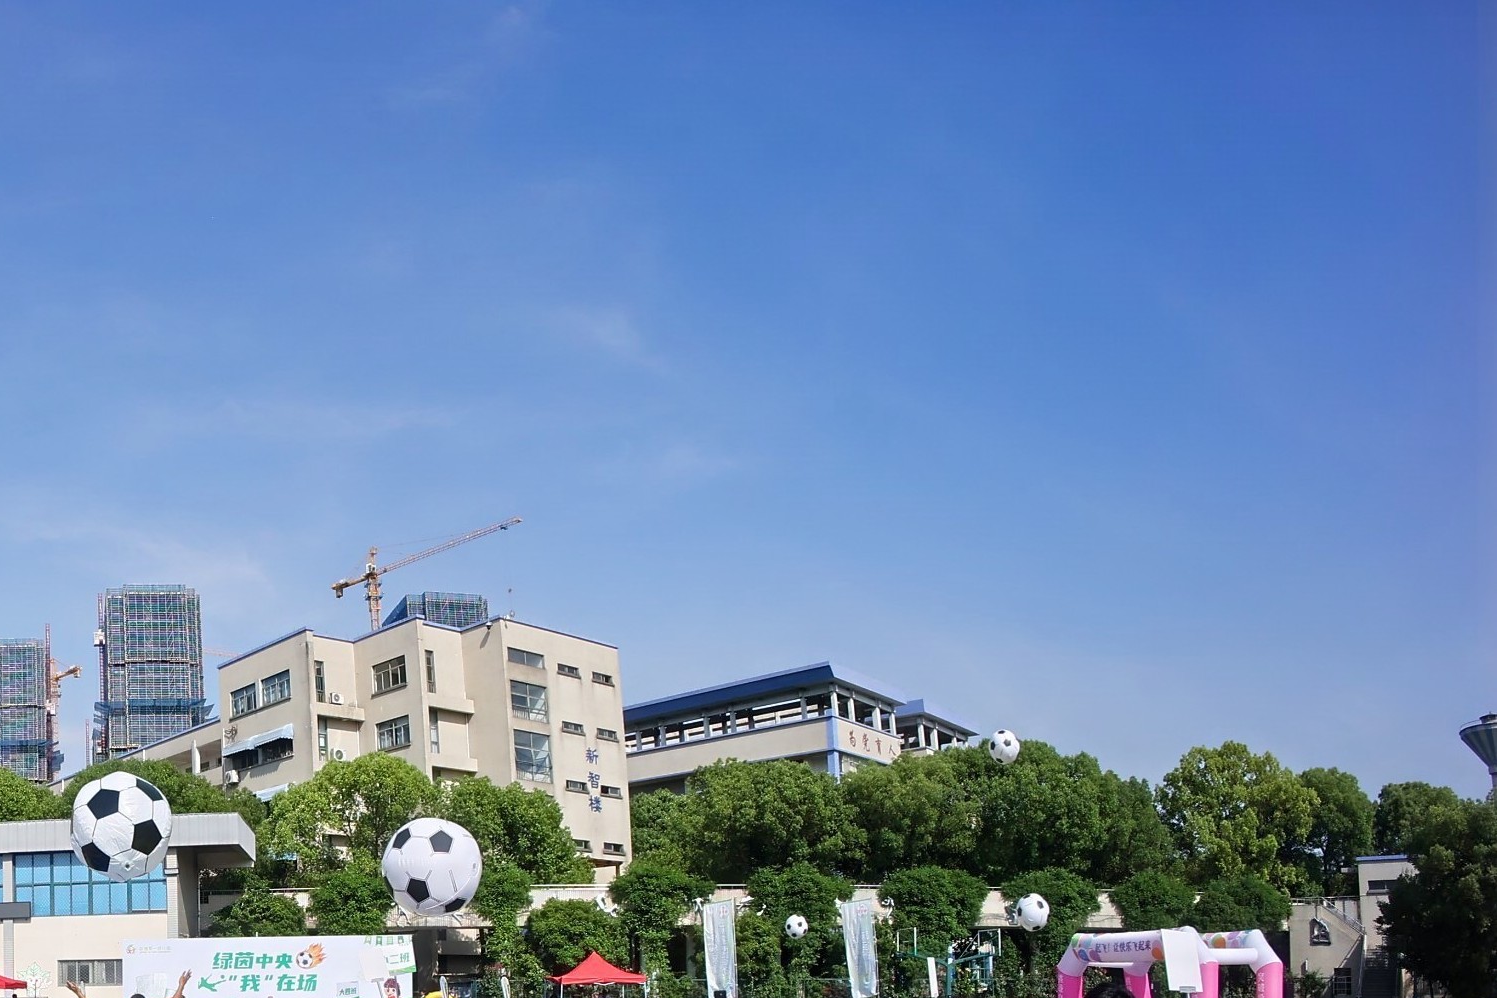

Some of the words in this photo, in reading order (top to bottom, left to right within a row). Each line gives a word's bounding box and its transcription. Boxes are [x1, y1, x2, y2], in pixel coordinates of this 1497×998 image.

[586, 746, 602, 813] 新智楼
[212, 951, 293, 970] 绿茵中央
